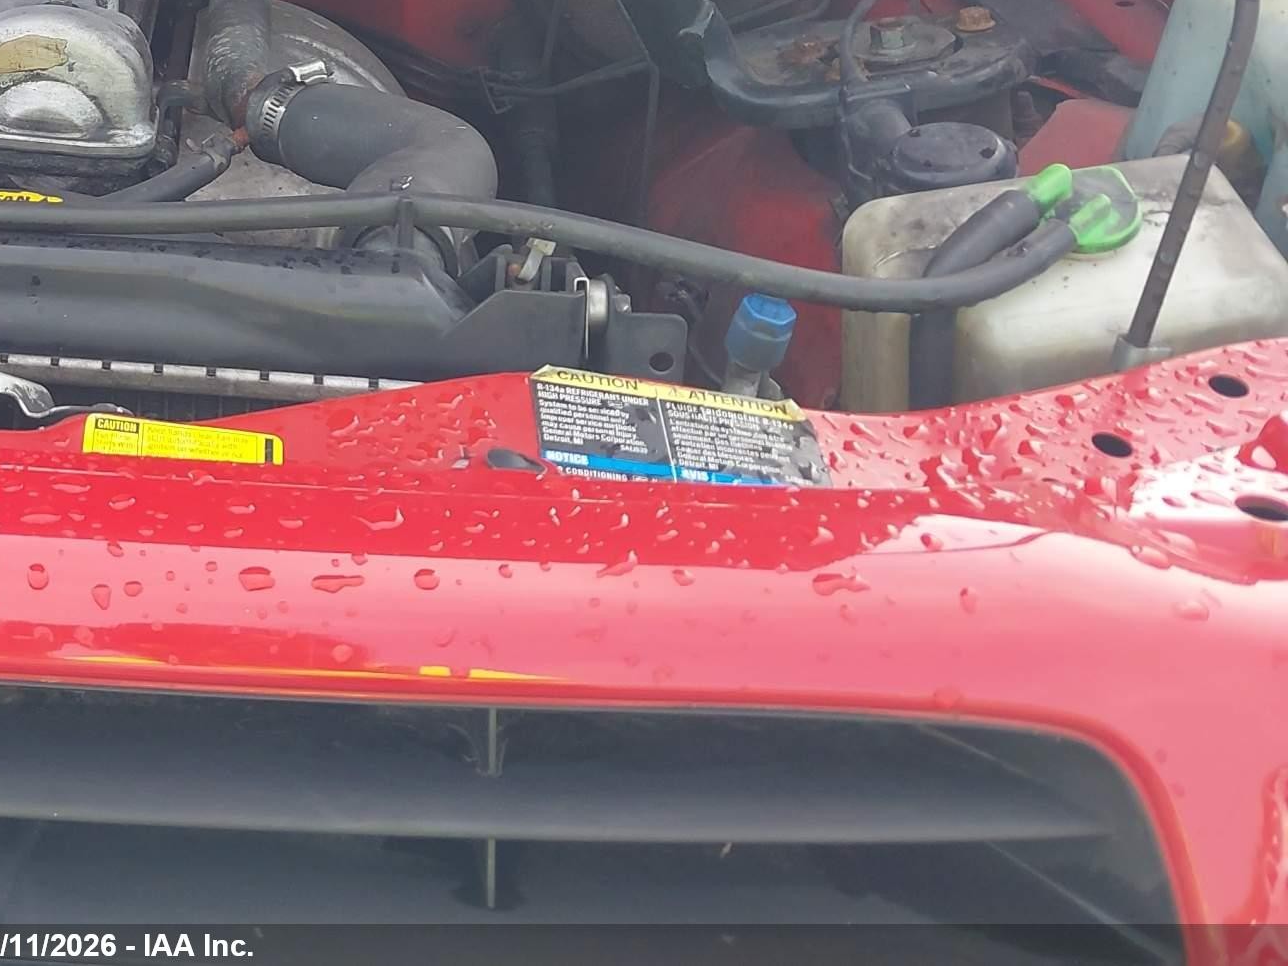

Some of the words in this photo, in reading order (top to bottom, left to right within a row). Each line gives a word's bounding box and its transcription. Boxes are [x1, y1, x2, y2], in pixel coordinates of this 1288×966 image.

[557, 371, 638, 390] CAUTION
[536, 382, 565, 393] R-134a
[565, 385, 621, 402] REFRIGERANT
[621, 394, 649, 406] UNDER
[537, 389, 558, 399] HIGH
[559, 392, 601, 406] PRESSURE
[538, 397, 567, 409] System
[689, 390, 787, 414] ATTENTION
[96, 418, 137, 432] CAUTION
[546, 451, 589, 465] NOTICE
[566, 467, 628, 481] CONDITIONING
